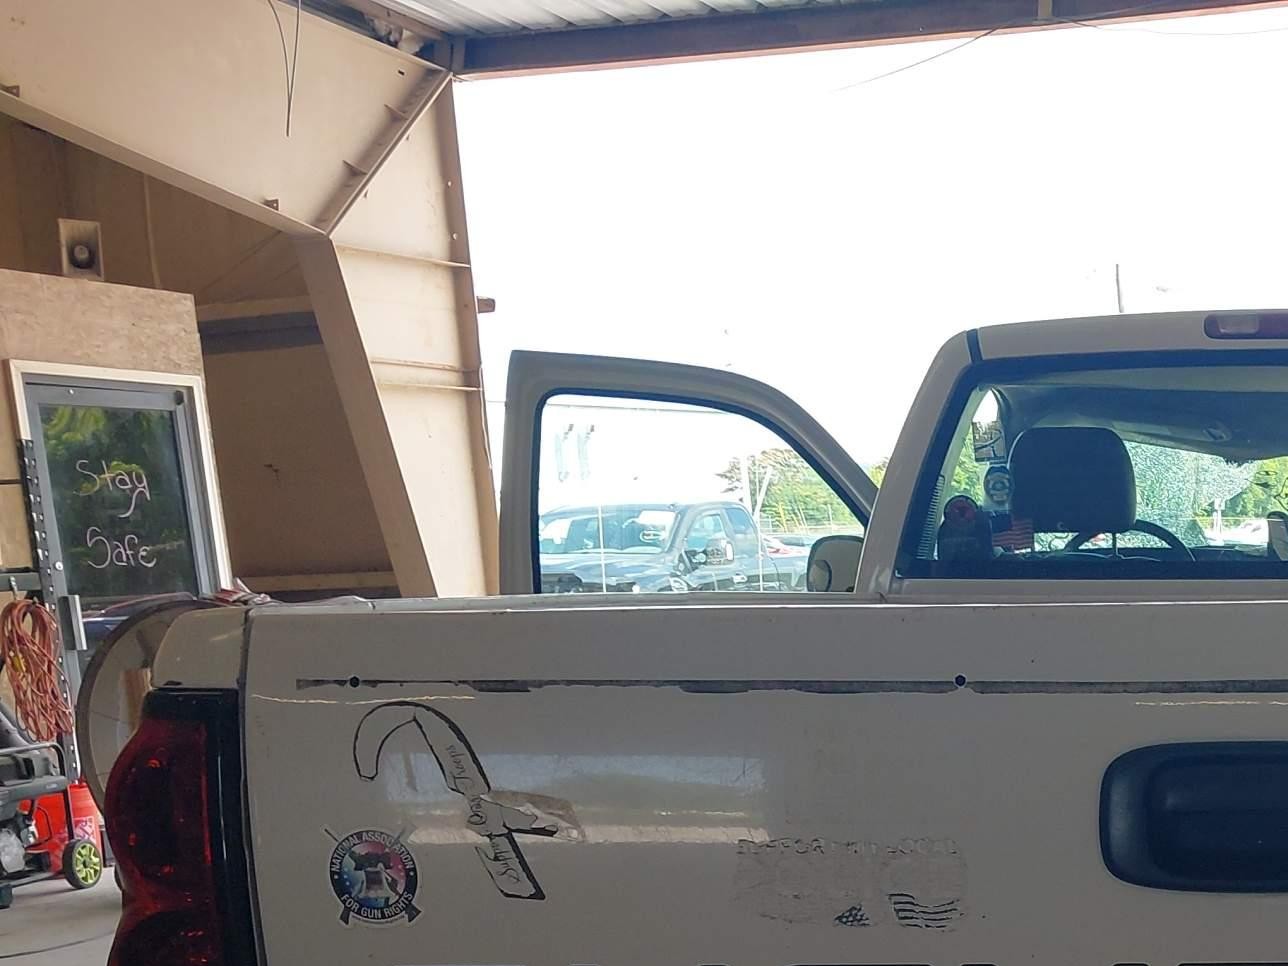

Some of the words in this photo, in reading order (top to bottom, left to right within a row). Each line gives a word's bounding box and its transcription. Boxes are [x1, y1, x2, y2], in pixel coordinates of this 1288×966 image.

[72, 459, 150, 518] Stay
[86, 526, 156, 568] Safe
[446, 744, 471, 795] Troops
[330, 832, 361, 873] NATIONAL
[341, 893, 359, 913] FOR
[360, 906, 382, 919] GUN
[384, 891, 413, 918] RIGHTS
